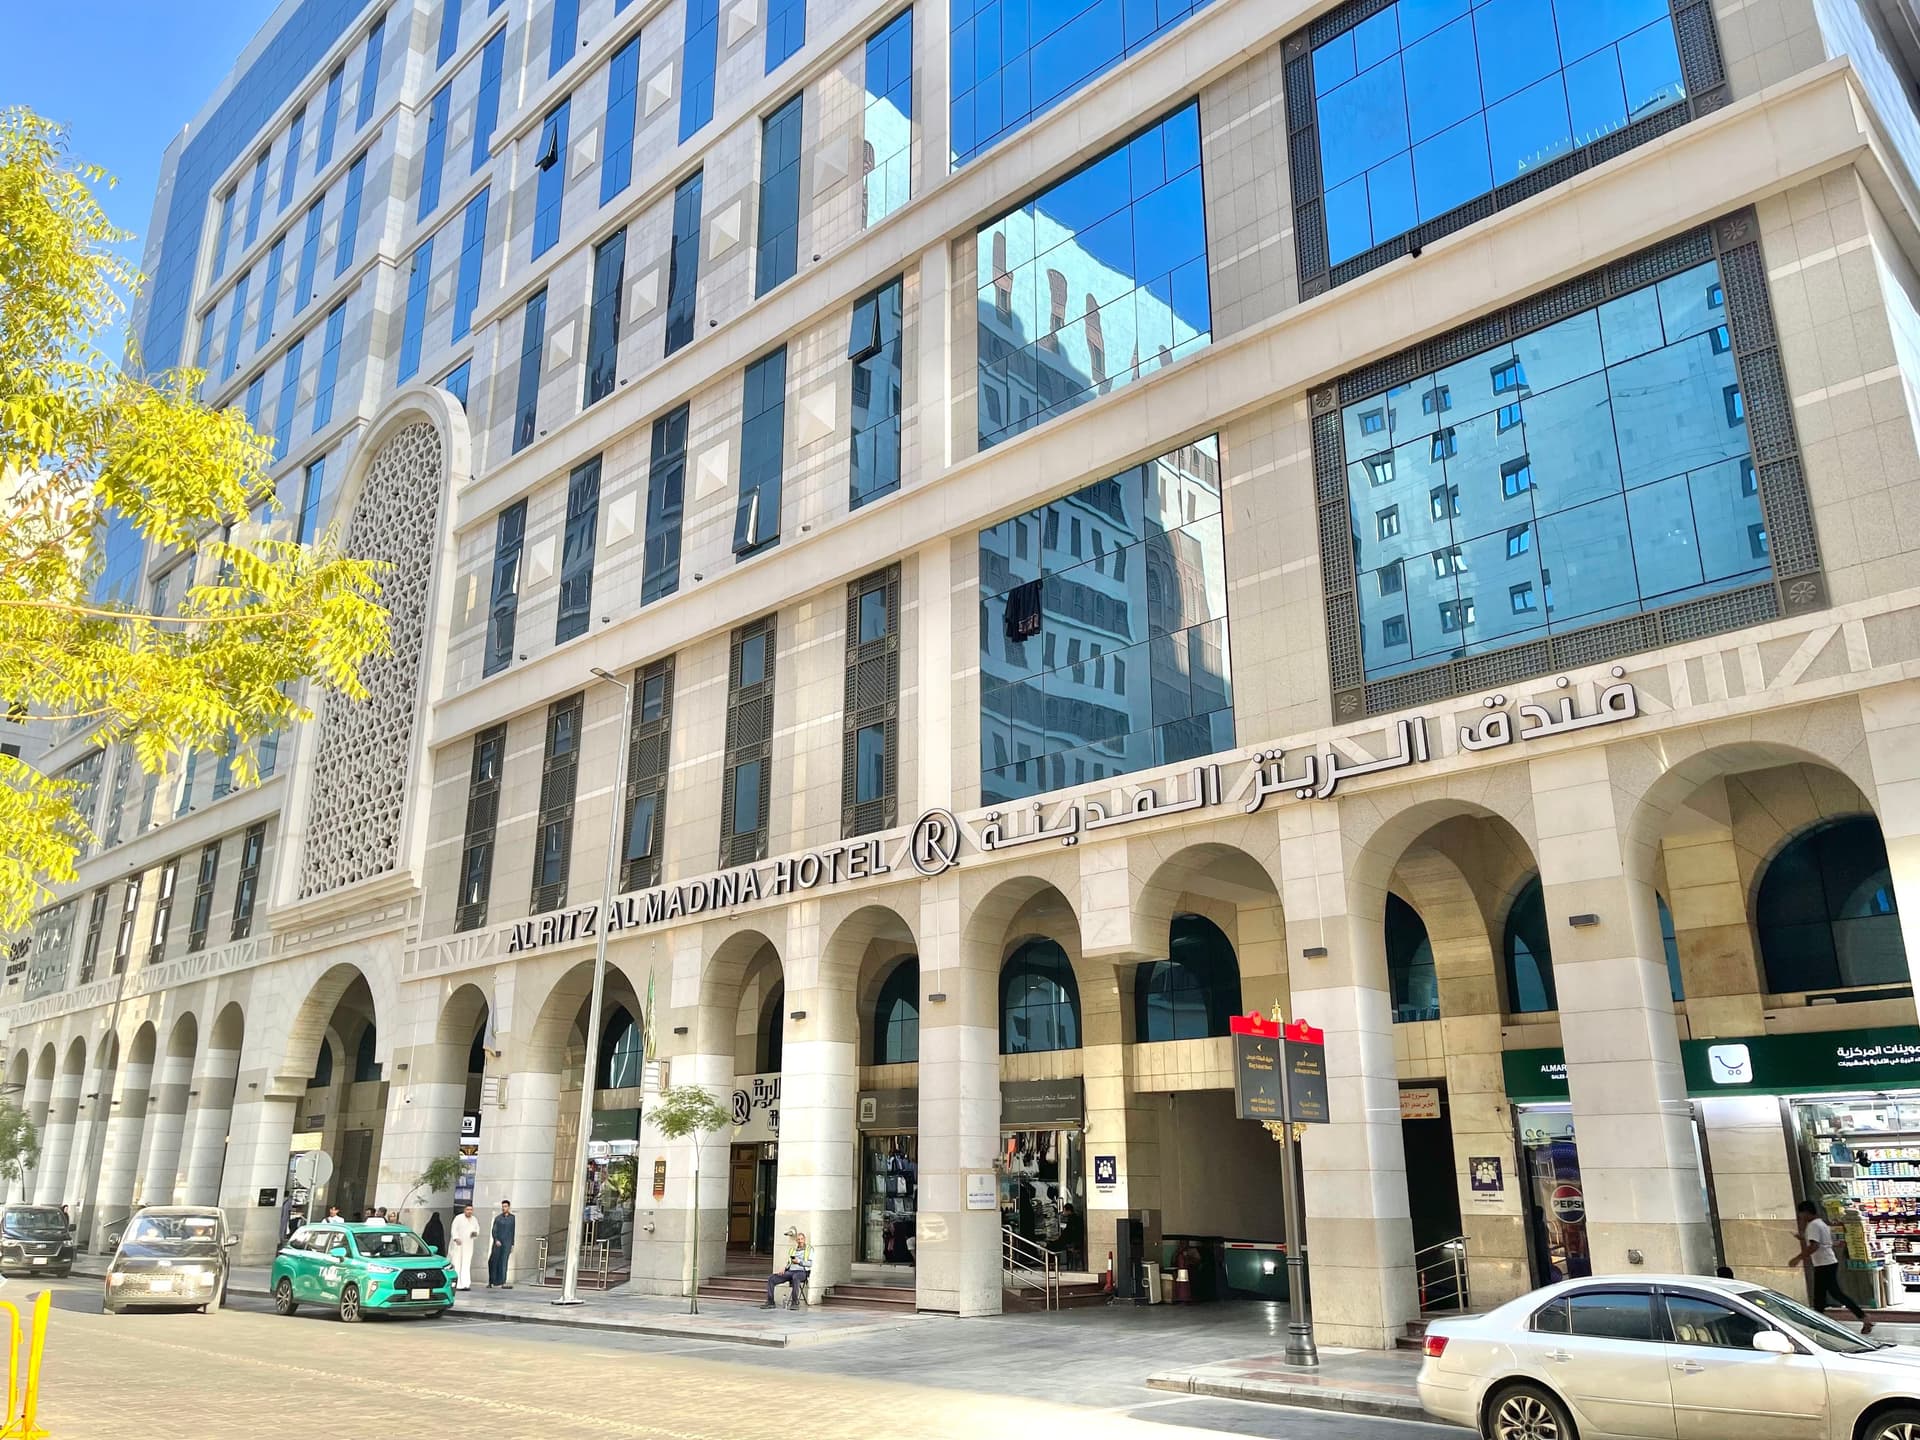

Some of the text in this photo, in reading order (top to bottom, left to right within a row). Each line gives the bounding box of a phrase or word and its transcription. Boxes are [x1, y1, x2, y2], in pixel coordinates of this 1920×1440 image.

[980, 664, 1639, 852] فندق الريتز المدينة
[507, 839, 891, 953] AL RITZ AL MADINA HOTEL
[1836, 1045, 1882, 1059] المركزية
